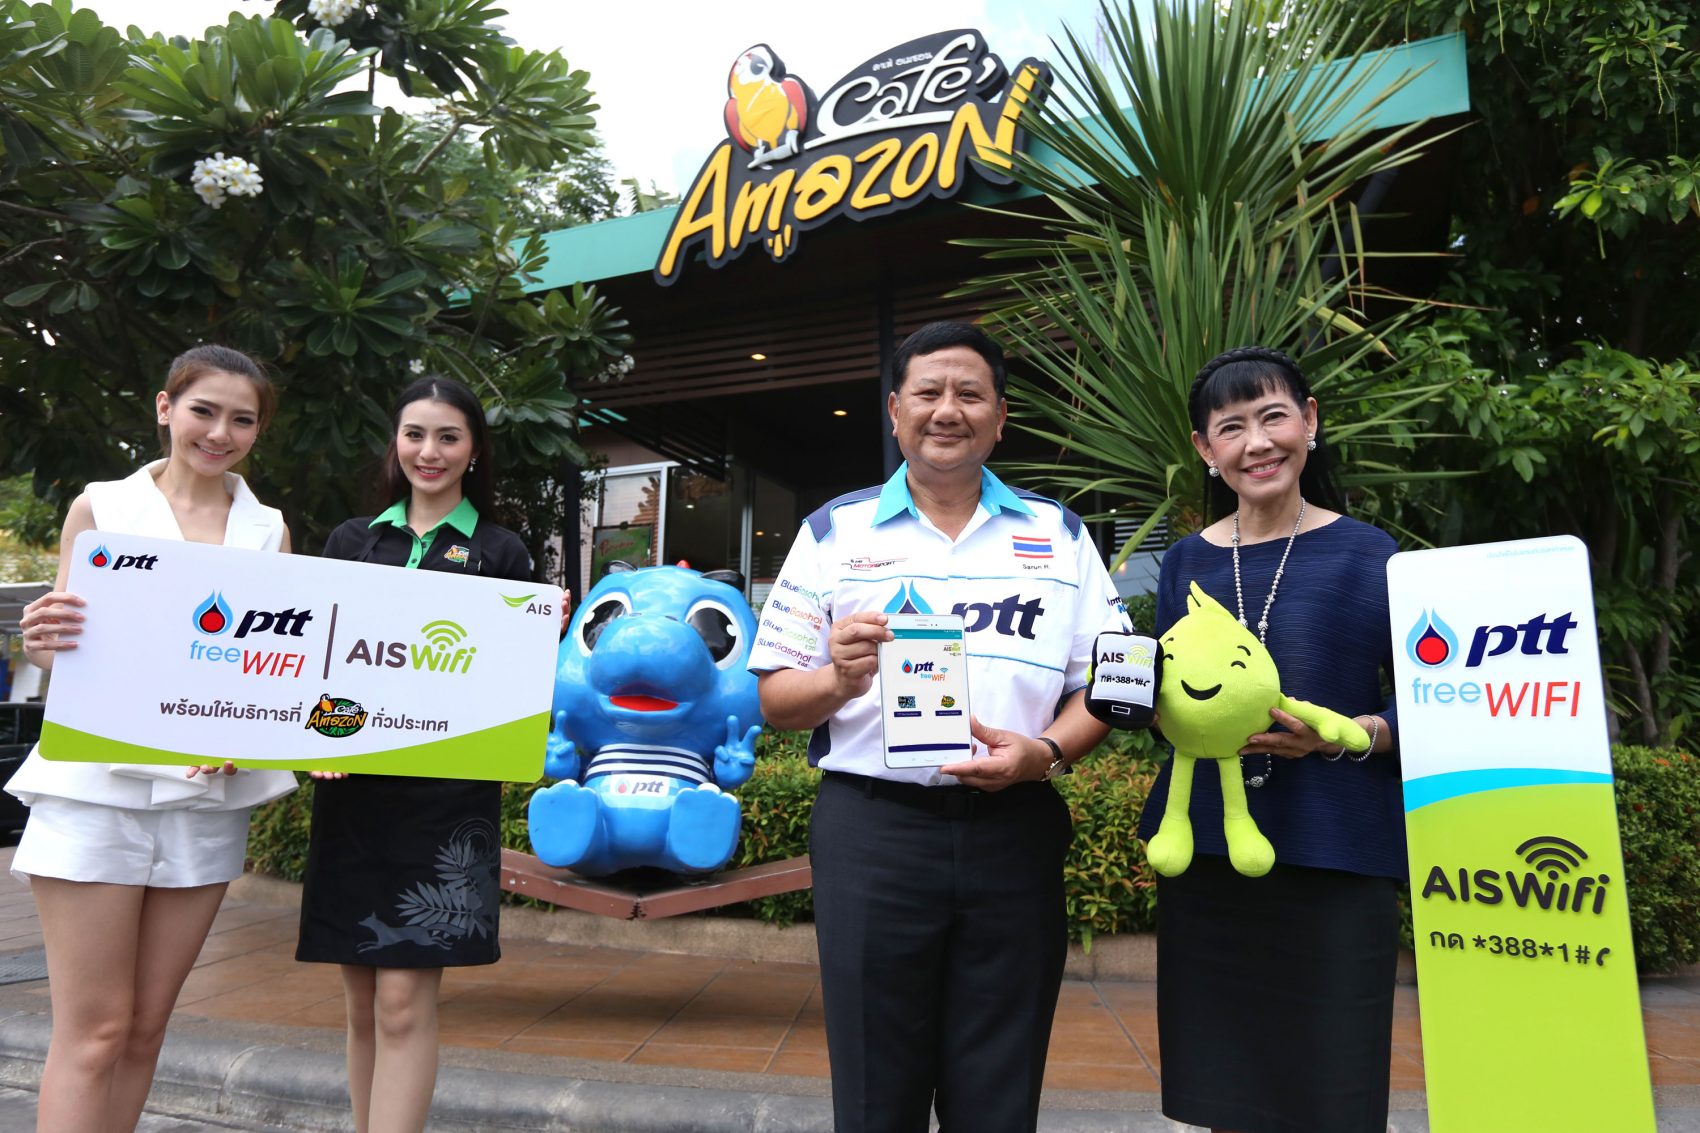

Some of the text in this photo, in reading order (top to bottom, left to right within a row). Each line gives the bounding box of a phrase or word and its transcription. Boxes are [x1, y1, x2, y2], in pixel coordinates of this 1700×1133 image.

[112, 555, 159, 571] ptt
[525, 603, 552, 616] AIS
[951, 593, 1045, 641] ptt
[233, 607, 314, 639] ptt
[1465, 611, 1578, 667] ptt
[914, 661, 934, 674] ptt
[160, 699, 303, 723] พร้อมให้บริการที่
[372, 708, 449, 733] ทั่วประเทศ
[632, 780, 664, 794] ptt
[1430, 931, 1465, 950] กด
